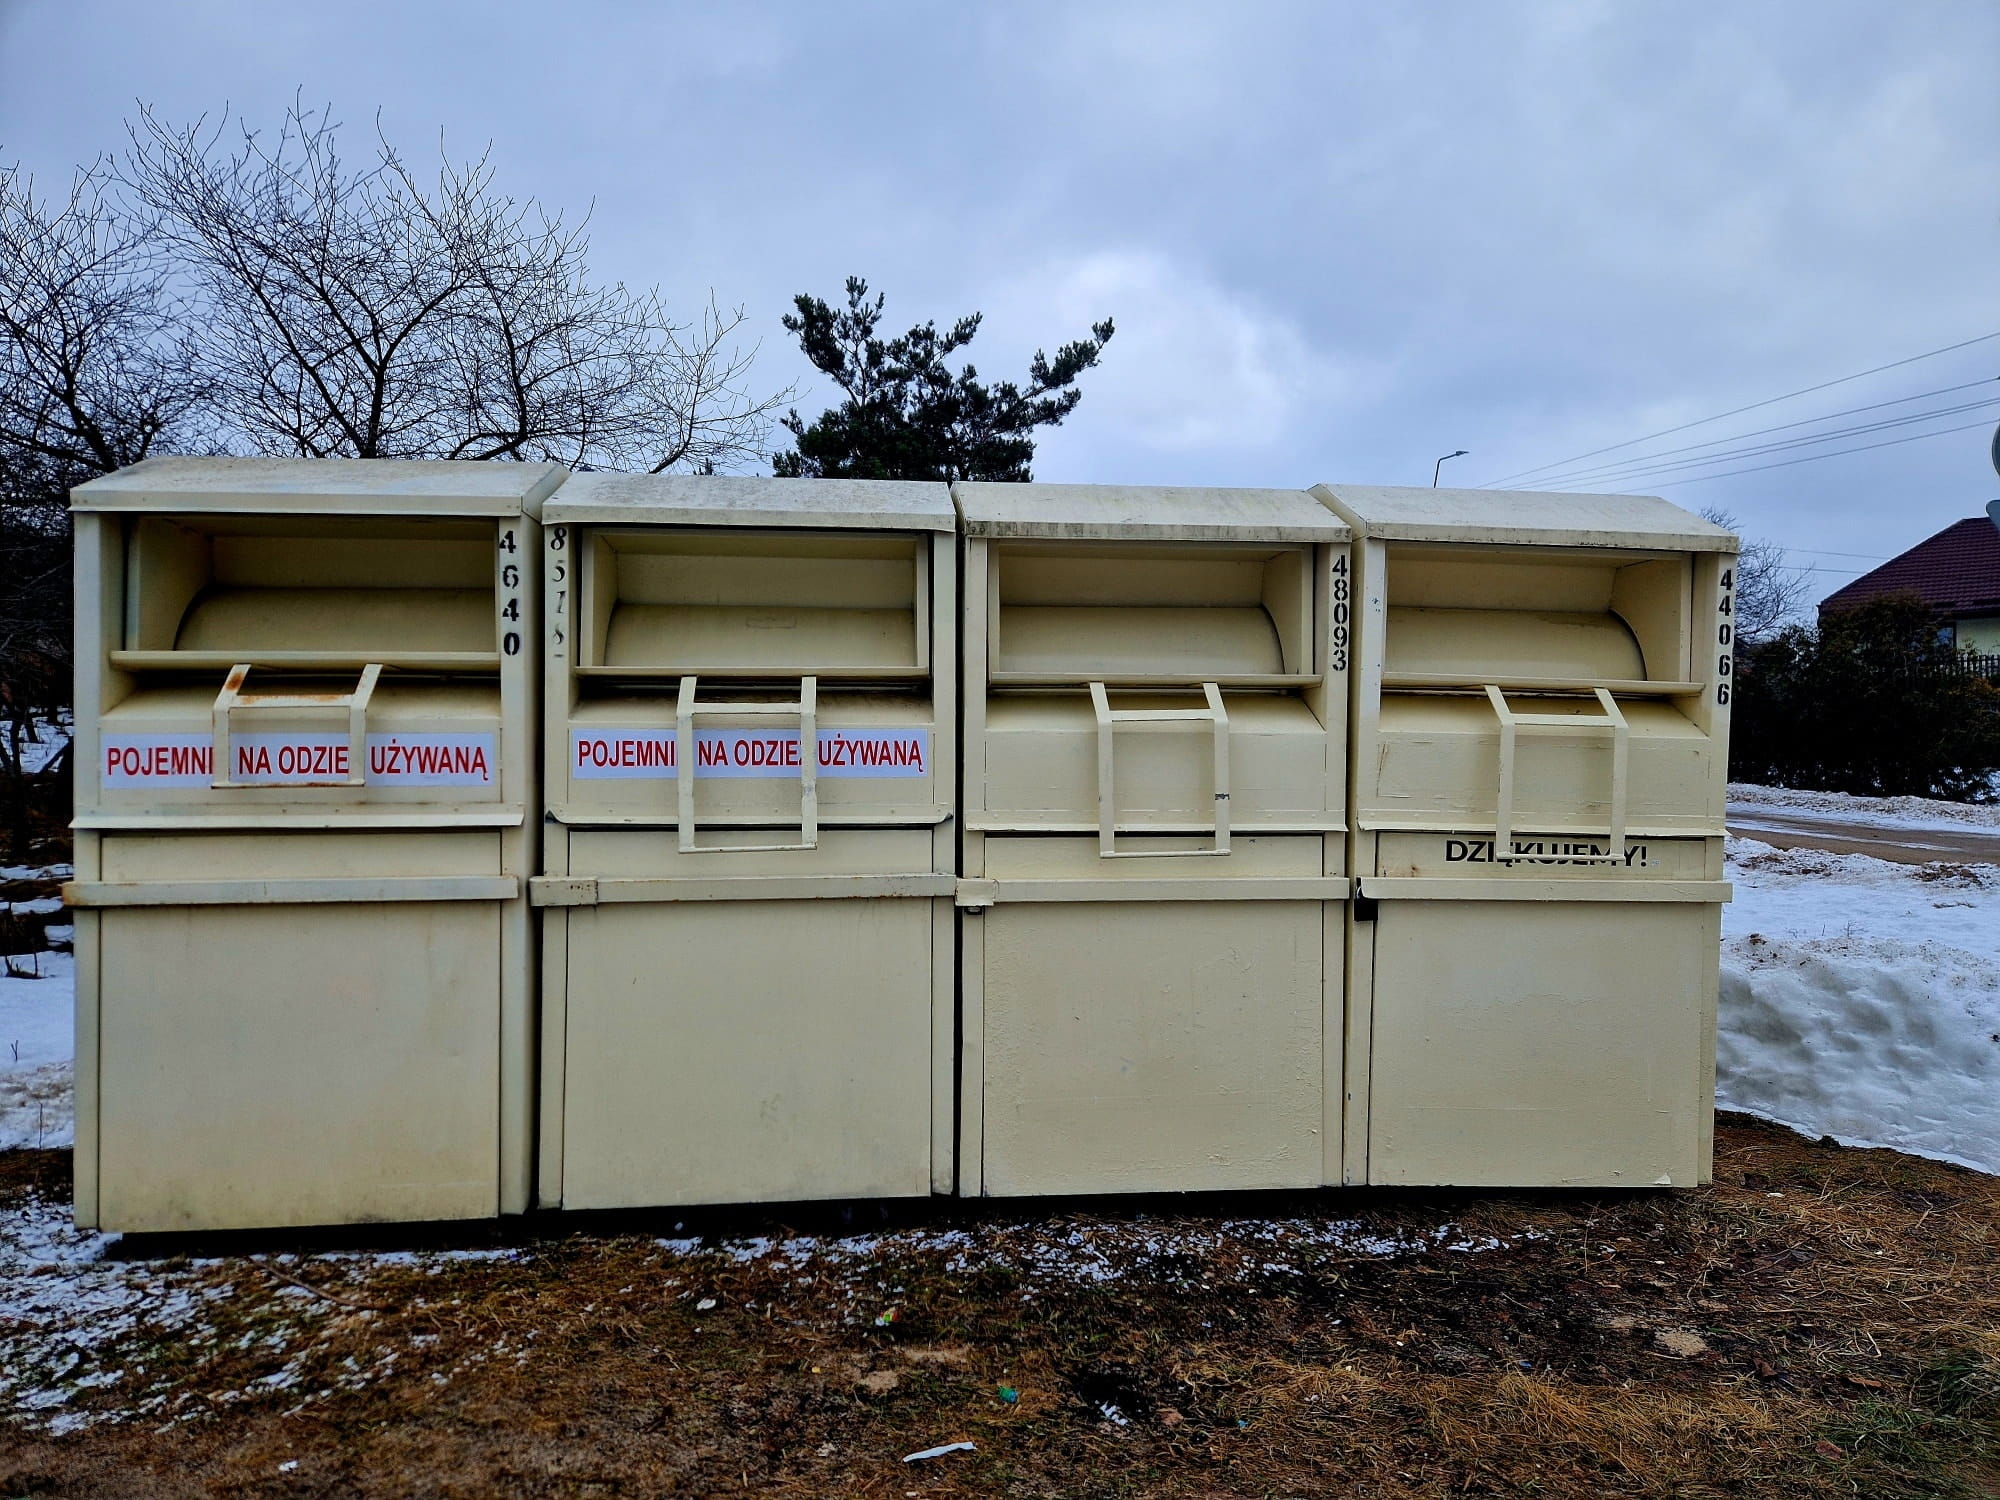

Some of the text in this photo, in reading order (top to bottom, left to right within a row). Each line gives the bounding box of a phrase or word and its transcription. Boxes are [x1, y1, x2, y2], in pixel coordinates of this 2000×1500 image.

[499, 530, 520, 656] 4640
[1332, 554, 1349, 672] 48093
[1717, 569, 1733, 705] 44066
[106, 738, 489, 781] POJEMNI NA ODZIE UŻYWANĄ
[578, 733, 924, 772] POJEMNI NA ODZIE UŻYWANĄ
